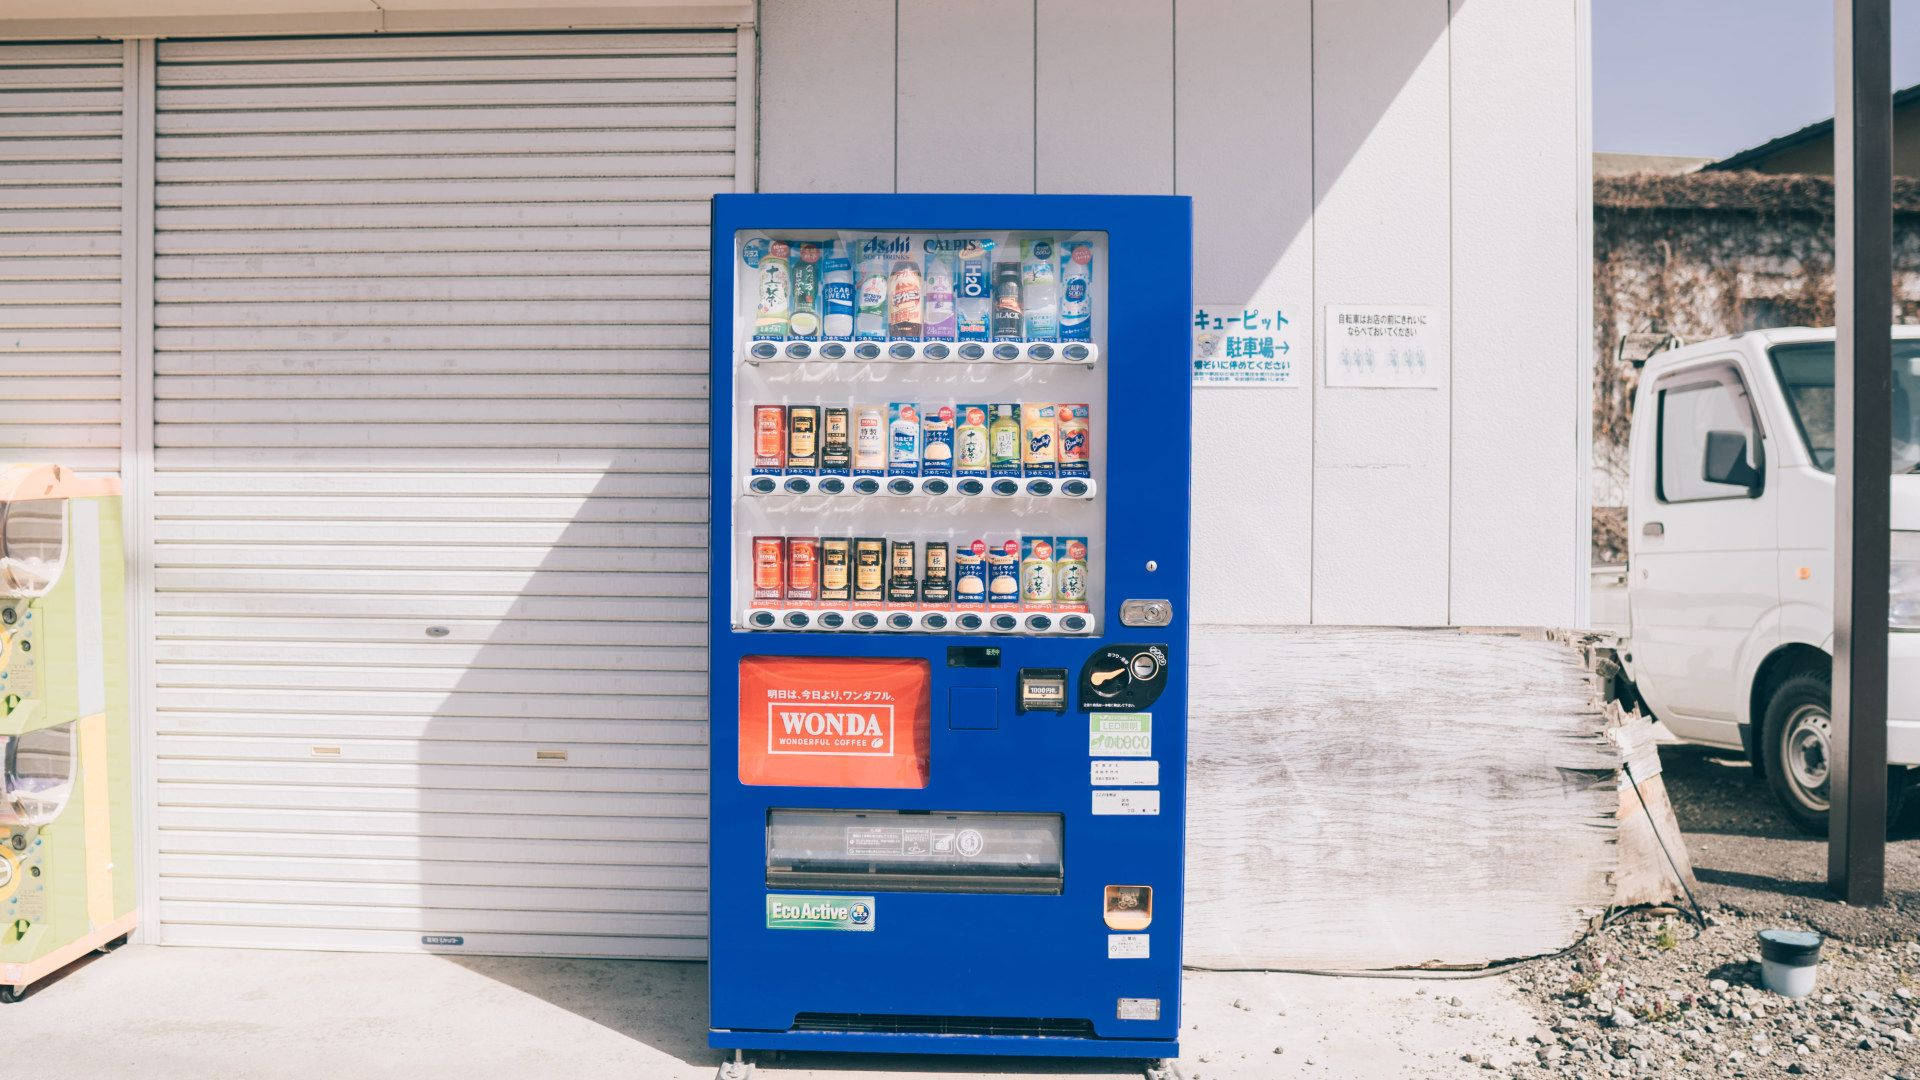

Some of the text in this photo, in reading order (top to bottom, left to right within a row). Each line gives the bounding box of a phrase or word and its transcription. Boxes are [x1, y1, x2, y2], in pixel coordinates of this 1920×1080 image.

[863, 235, 910, 253] Asahi
[923, 239, 976, 254] CALPIS
[995, 312, 1020, 320] BLACK
[1195, 309, 1289, 331] キューピット
[1338, 313, 1427, 325] 自転車はお店の前にきれいに
[1347, 326, 1418, 337] ならべておいてください
[1226, 336, 1275, 359] 駐車場
[767, 689, 896, 702] 明日は、今日より、ワンダフル。
[779, 711, 884, 737] WONDA
[779, 737, 867, 747] WONDERFUL COFFEE
[772, 902, 849, 921] Eco Active
